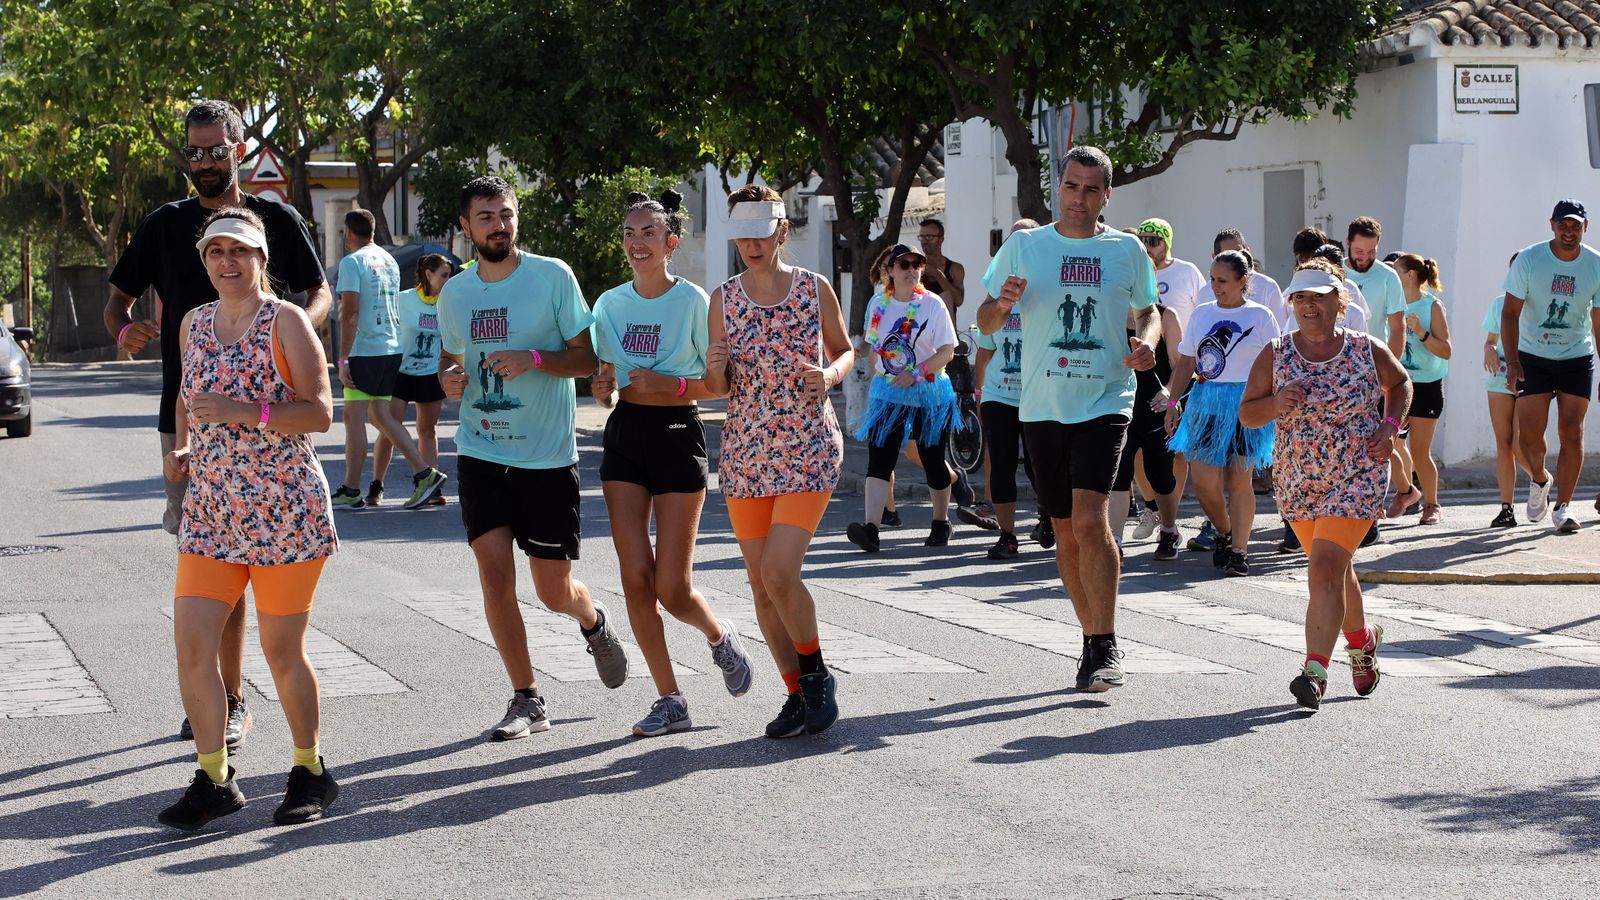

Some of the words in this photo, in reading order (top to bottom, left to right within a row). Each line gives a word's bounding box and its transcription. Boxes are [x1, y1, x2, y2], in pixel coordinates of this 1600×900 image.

[1473, 74, 1513, 83] CALLE
[1457, 97, 1516, 105] BERLANGUILLA
[1062, 255, 1069, 263] V
[1069, 256, 1092, 264] carrera
[1092, 256, 1101, 265] del
[1061, 264, 1101, 282] BARRO
[1552, 280, 1576, 293] BARRO
[472, 309, 478, 318] V
[477, 308, 499, 318] carrera
[500, 306, 508, 316] del
[471, 318, 508, 339] BARRO
[626, 322, 633, 331] V
[632, 324, 653, 332] carrera
[653, 323, 661, 332] del
[1003, 318, 1022, 330] ARR
[622, 333, 660, 352] BARRO
